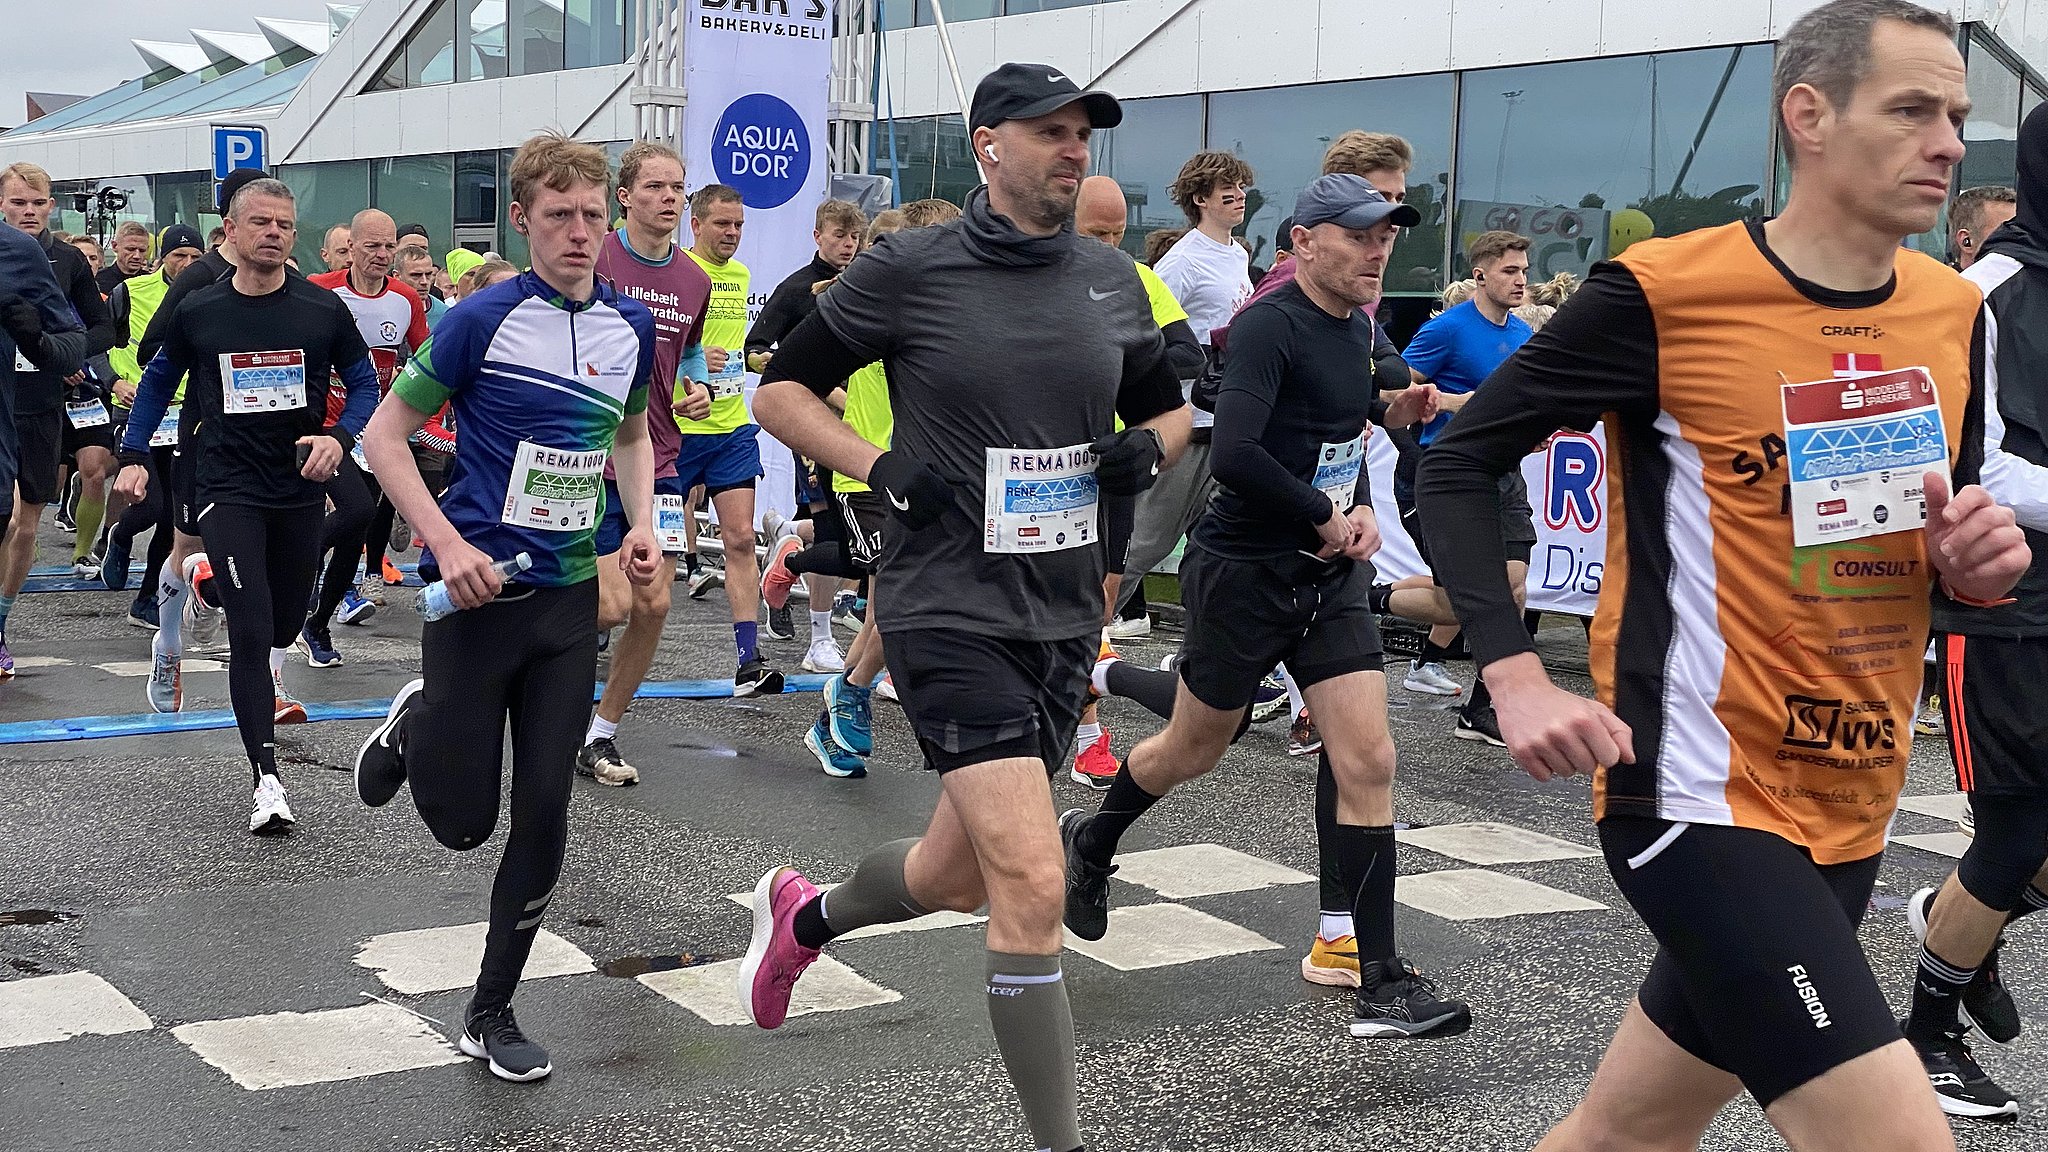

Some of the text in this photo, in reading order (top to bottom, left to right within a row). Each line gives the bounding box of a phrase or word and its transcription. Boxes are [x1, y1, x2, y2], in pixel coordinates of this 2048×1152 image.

[723, 124, 800, 152] AQUA
[226, 135, 254, 174] P
[624, 285, 680, 307] Lillebælt
[1820, 325, 1872, 338] CRAFT
[536, 452, 604, 469] REMA 1000
[1009, 454, 1065, 473] REMA
[1731, 432, 1787, 486] SA
[986, 518, 995, 539] 1795
[1833, 560, 1920, 578] CONSULT
[1842, 718, 1896, 751] VVS
[1786, 964, 1832, 1029] FUSION
